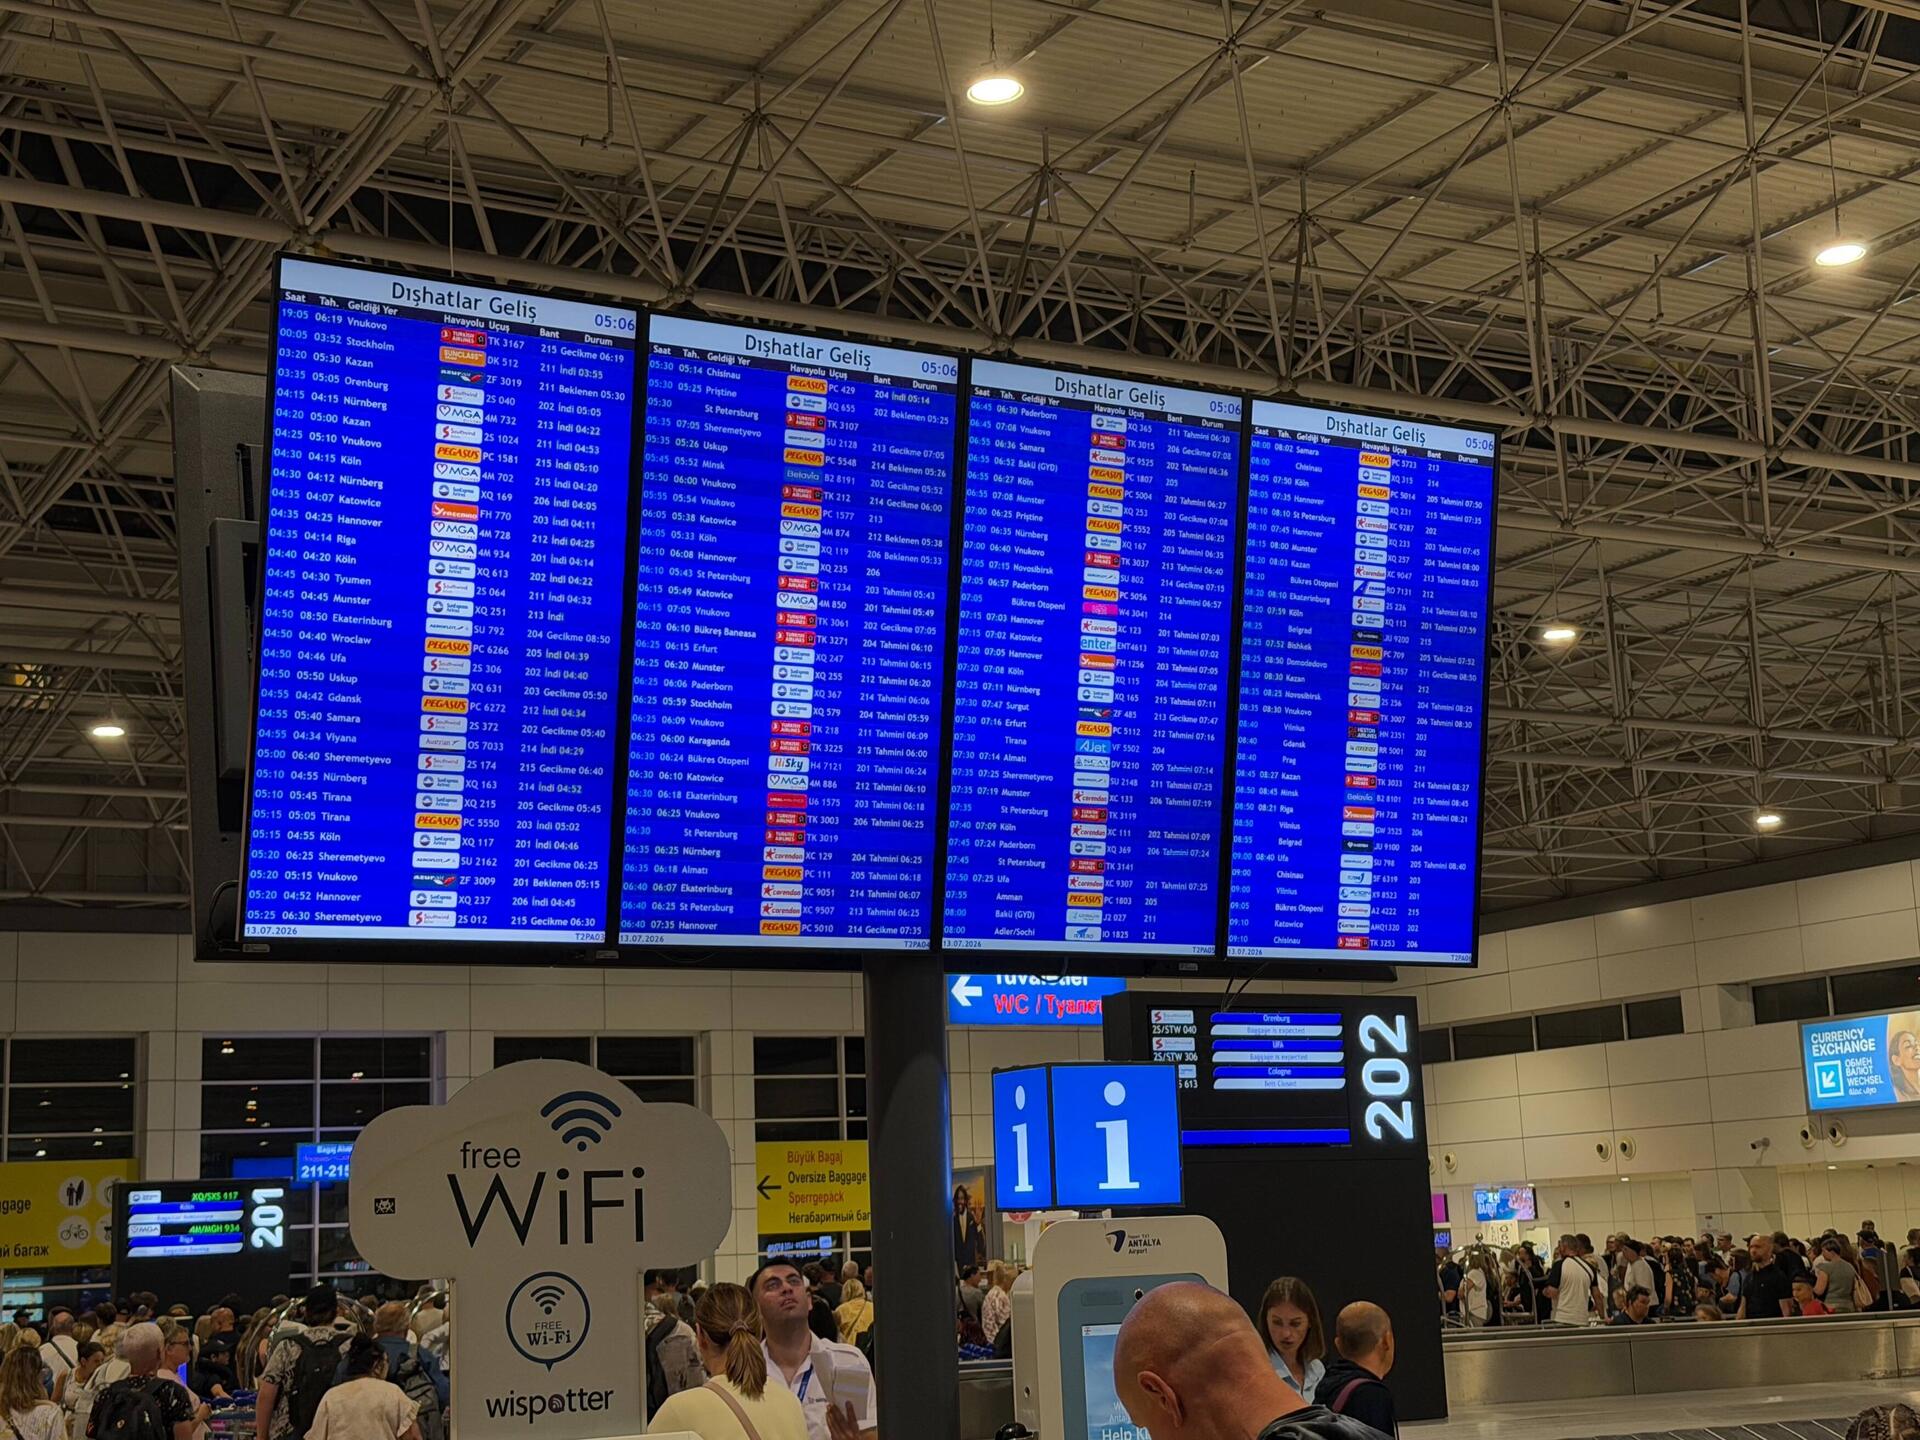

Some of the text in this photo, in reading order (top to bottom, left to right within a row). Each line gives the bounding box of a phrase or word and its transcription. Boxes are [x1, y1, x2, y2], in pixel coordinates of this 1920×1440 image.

[391, 281, 635, 331] Dışhatlar Geliş 05:06
[285, 291, 612, 346] Saat Tah. Geldiği Yer Havayolu Uçuş Bant Durum
[282, 307, 624, 363] 19:05 06:19 Vnukovo TK 3167 215 Gecikme 06:19
[745, 333, 957, 377] Dışhatlar Geliş 05:06
[277, 347, 625, 401] 03:20 05:30 Kazan ZF 3019 211 Beklenen 05:30
[1054, 376, 1241, 415] Dışhatlar Geliş 05:06
[451, 407, 481, 419] MGA
[1326, 415, 1494, 451] Dışhatlar Geliş 05:06
[436, 446, 480, 460] PEGASUS
[643, 470, 942, 512] 05:50 06:00 Vnukovo TK 212 214 Gecikme 06:00
[1359, 485, 1388, 497] PEGASUS
[263, 607, 610, 644] 04:50 08:50 Ekaterinburg SU 792 204 Gecikme 08:50
[1080, 637, 1111, 650] enter
[774, 757, 804, 771] HiSky
[249, 869, 600, 889] 05:20 05:15 Vnukovo ZF 3009 201 Beklenen 05:15
[245, 925, 298, 935] 13.07.2026
[621, 918, 921, 934] 06:40 07:35 Hannover PC 5010 214 Gecikme 07:35
[619, 933, 664, 942] 13.07.2026
[942, 940, 982, 948] 13.07.2026
[993, 993, 1029, 1014] WC
[1263, 1014, 1290, 1023] Orenburg
[1152, 1024, 1197, 1035] 2S/STW 040
[1811, 1028, 1864, 1043] CURRENCY
[1811, 1038, 1876, 1057] EXCHANGE
[1184, 1052, 1198, 1061] 306
[1184, 1079, 1199, 1089] 613
[1359, 1014, 1414, 1140] 202
[1846, 1075, 1884, 1086] WECHSEL
[460, 1141, 521, 1168] free
[787, 1150, 843, 1166] Büyük Bagaj
[788, 1169, 867, 1186] Oversize Baggage
[447, 1166, 645, 1248] WiFi
[251, 1188, 284, 1248] 201
[788, 1209, 854, 1225] Негабаритный
[13, 1243, 49, 1257] багаж
[1128, 1238, 1161, 1248] ANTALYA
[534, 1320, 563, 1331] FREE
[526, 1329, 572, 1346] Wi-Fi
[485, 1388, 615, 1424] wispotter
[1102, 1426, 1132, 1440] Help
